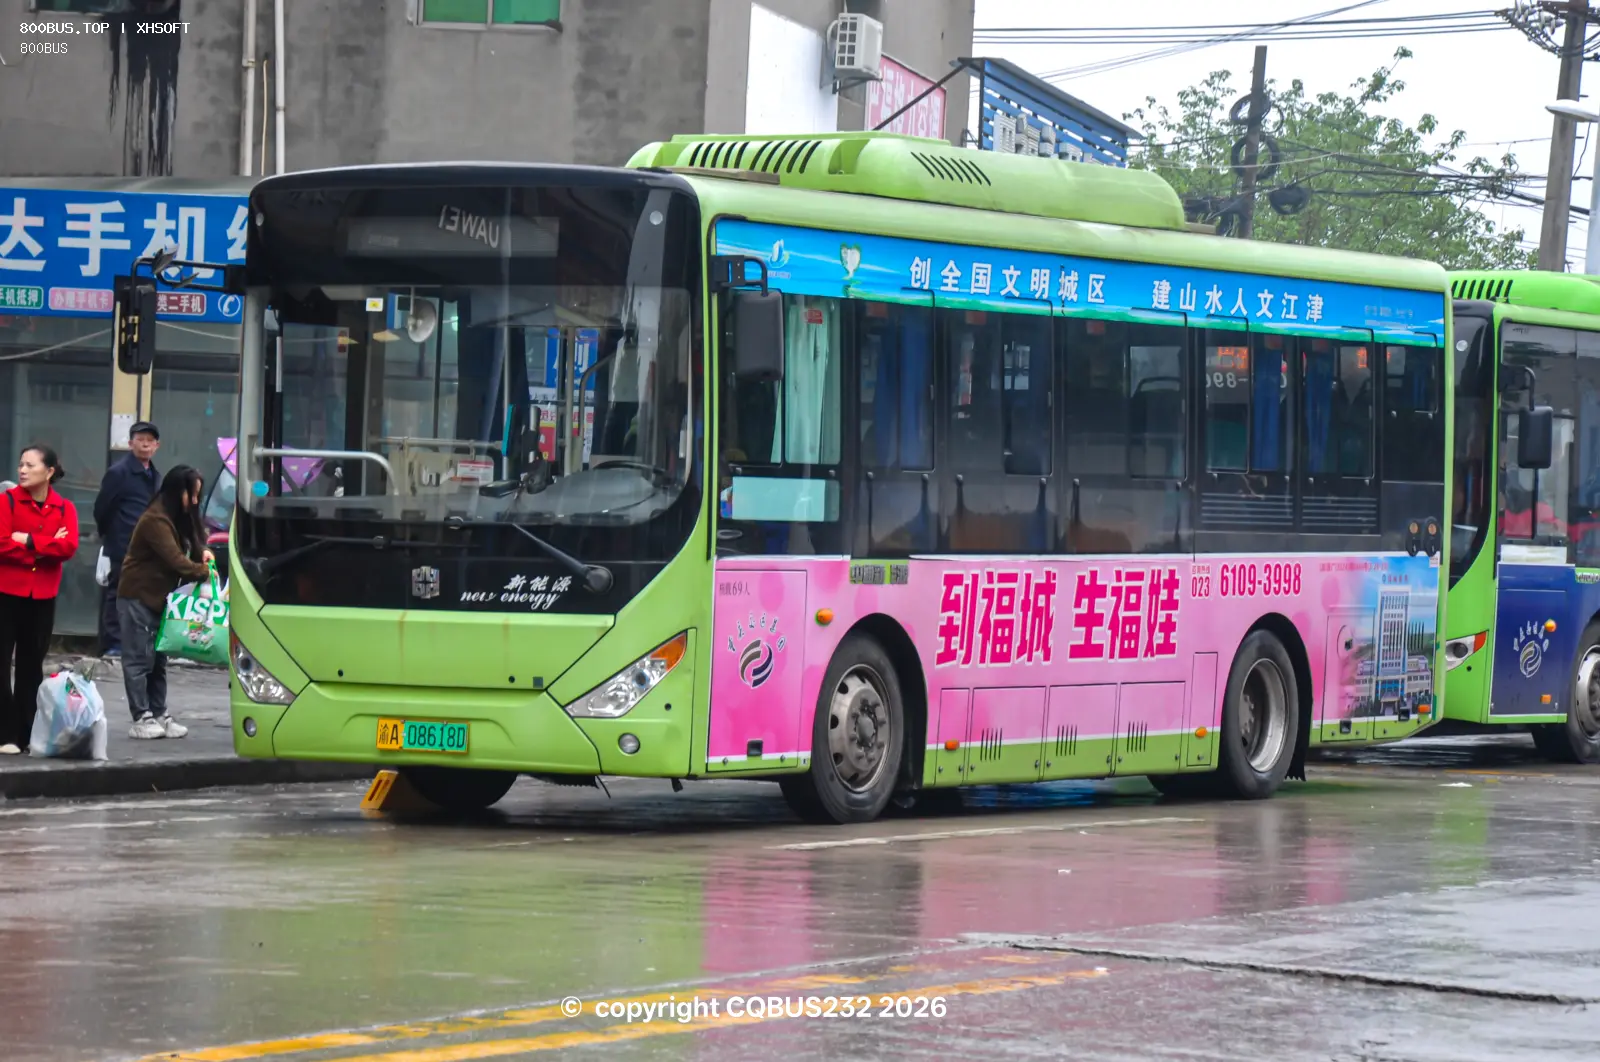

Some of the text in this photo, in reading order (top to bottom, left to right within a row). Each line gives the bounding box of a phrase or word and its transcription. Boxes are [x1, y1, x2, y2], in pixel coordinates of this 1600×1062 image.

[909, 256, 1106, 304] 创全国文明城区
[1152, 279, 1325, 323] 建山水人文江津
[503, 574, 572, 592] 新能源
[1192, 563, 1301, 597] 023 6109-3998
[500, 592, 560, 610] energy
[935, 569, 1181, 666] 到福城 生福娃
